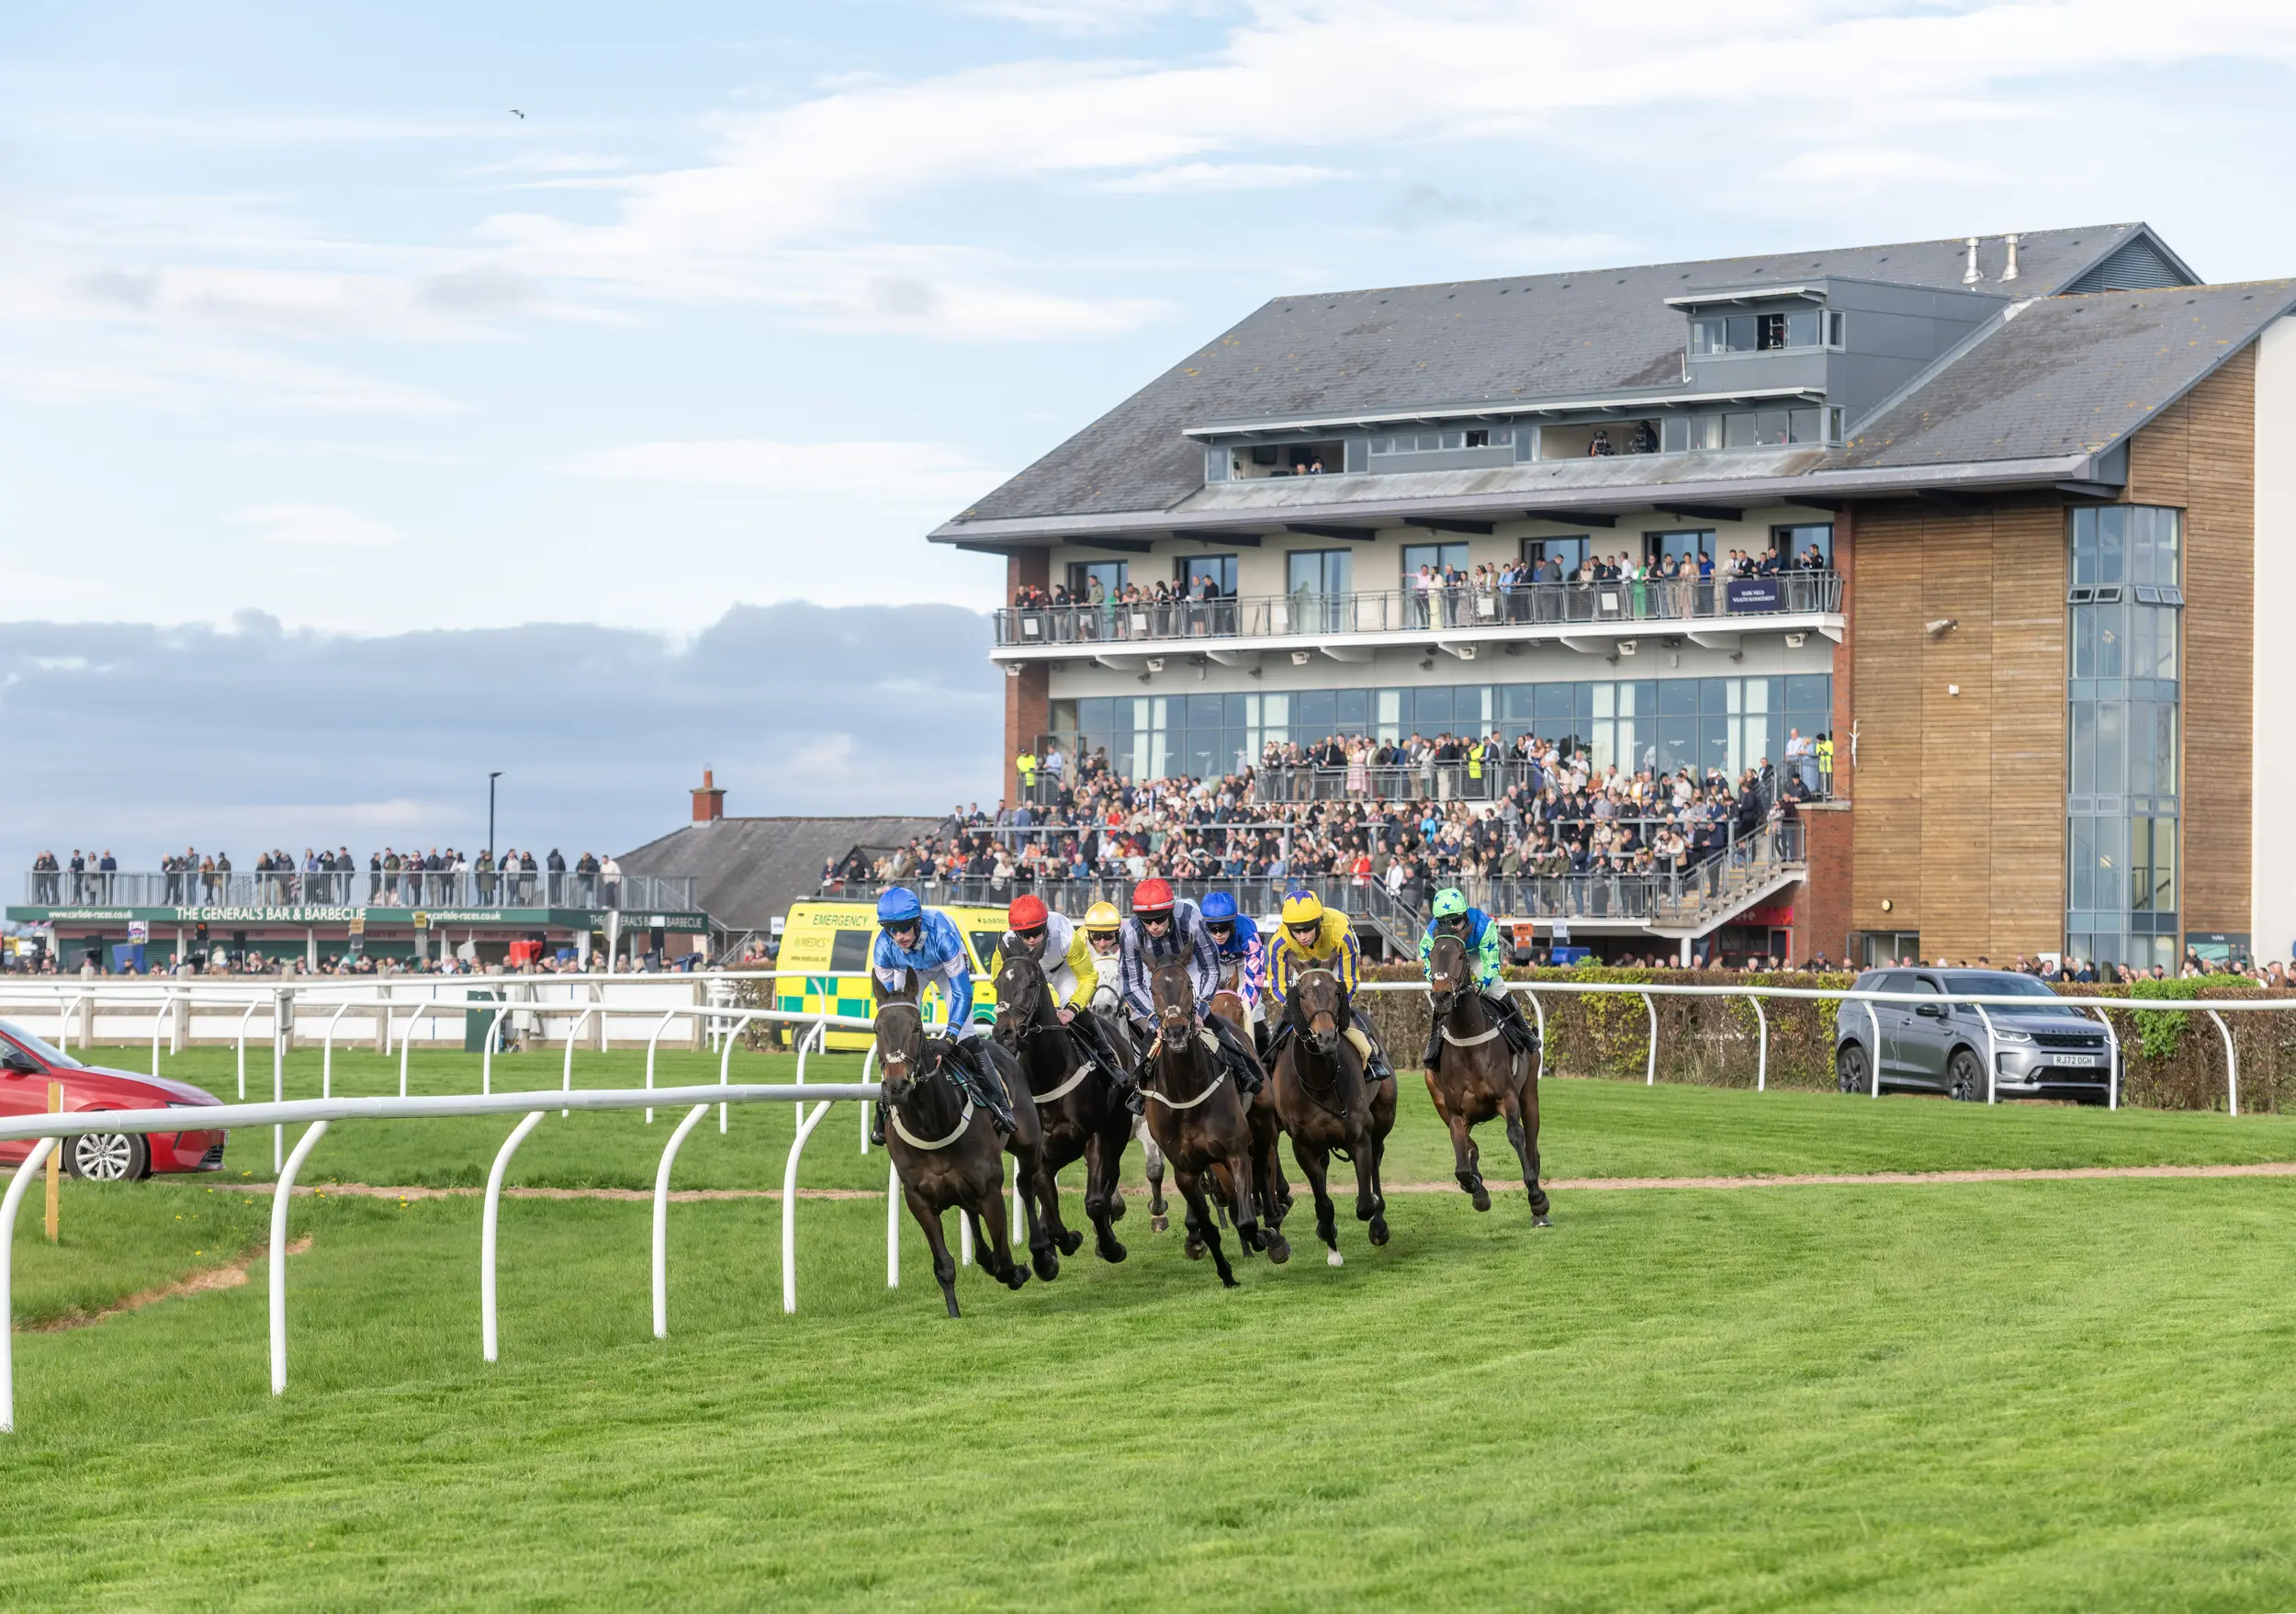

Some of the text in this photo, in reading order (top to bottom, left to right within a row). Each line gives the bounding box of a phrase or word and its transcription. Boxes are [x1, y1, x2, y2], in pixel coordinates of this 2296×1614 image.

[48, 909, 133, 920] www.carlisle-races.co.uk
[175, 907, 366, 920] THE GENERAL'S BAR & BARBECUE
[589, 915, 604, 926] THE
[666, 917, 702, 929] BARBECUE
[813, 914, 869, 927] EMERGENCY
[802, 937, 827, 948] MEDICS
[2056, 1056, 2077, 1065] RJ72
